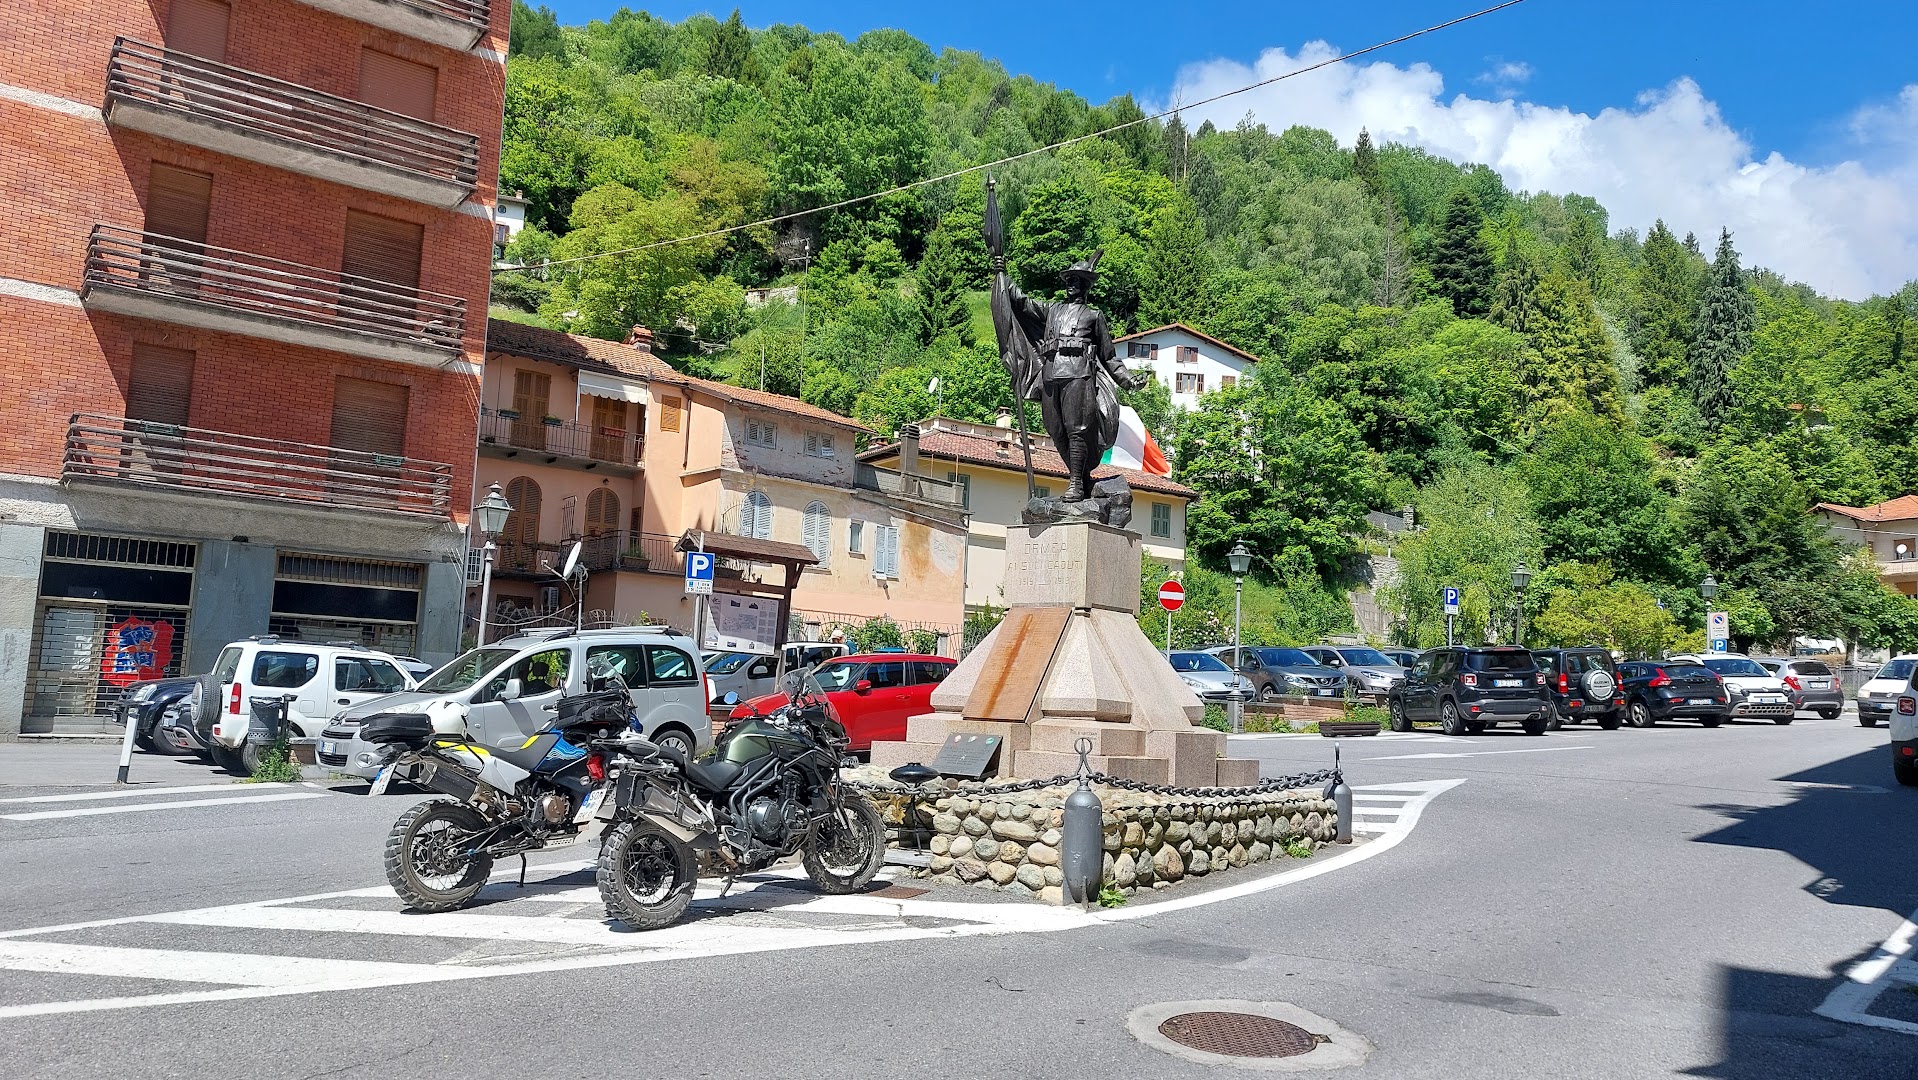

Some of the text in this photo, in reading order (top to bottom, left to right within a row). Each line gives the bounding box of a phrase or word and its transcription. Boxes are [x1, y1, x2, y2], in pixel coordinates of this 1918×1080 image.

[691, 555, 710, 577] P
[1447, 589, 1457, 604] P
[1715, 640, 1724, 651] P
